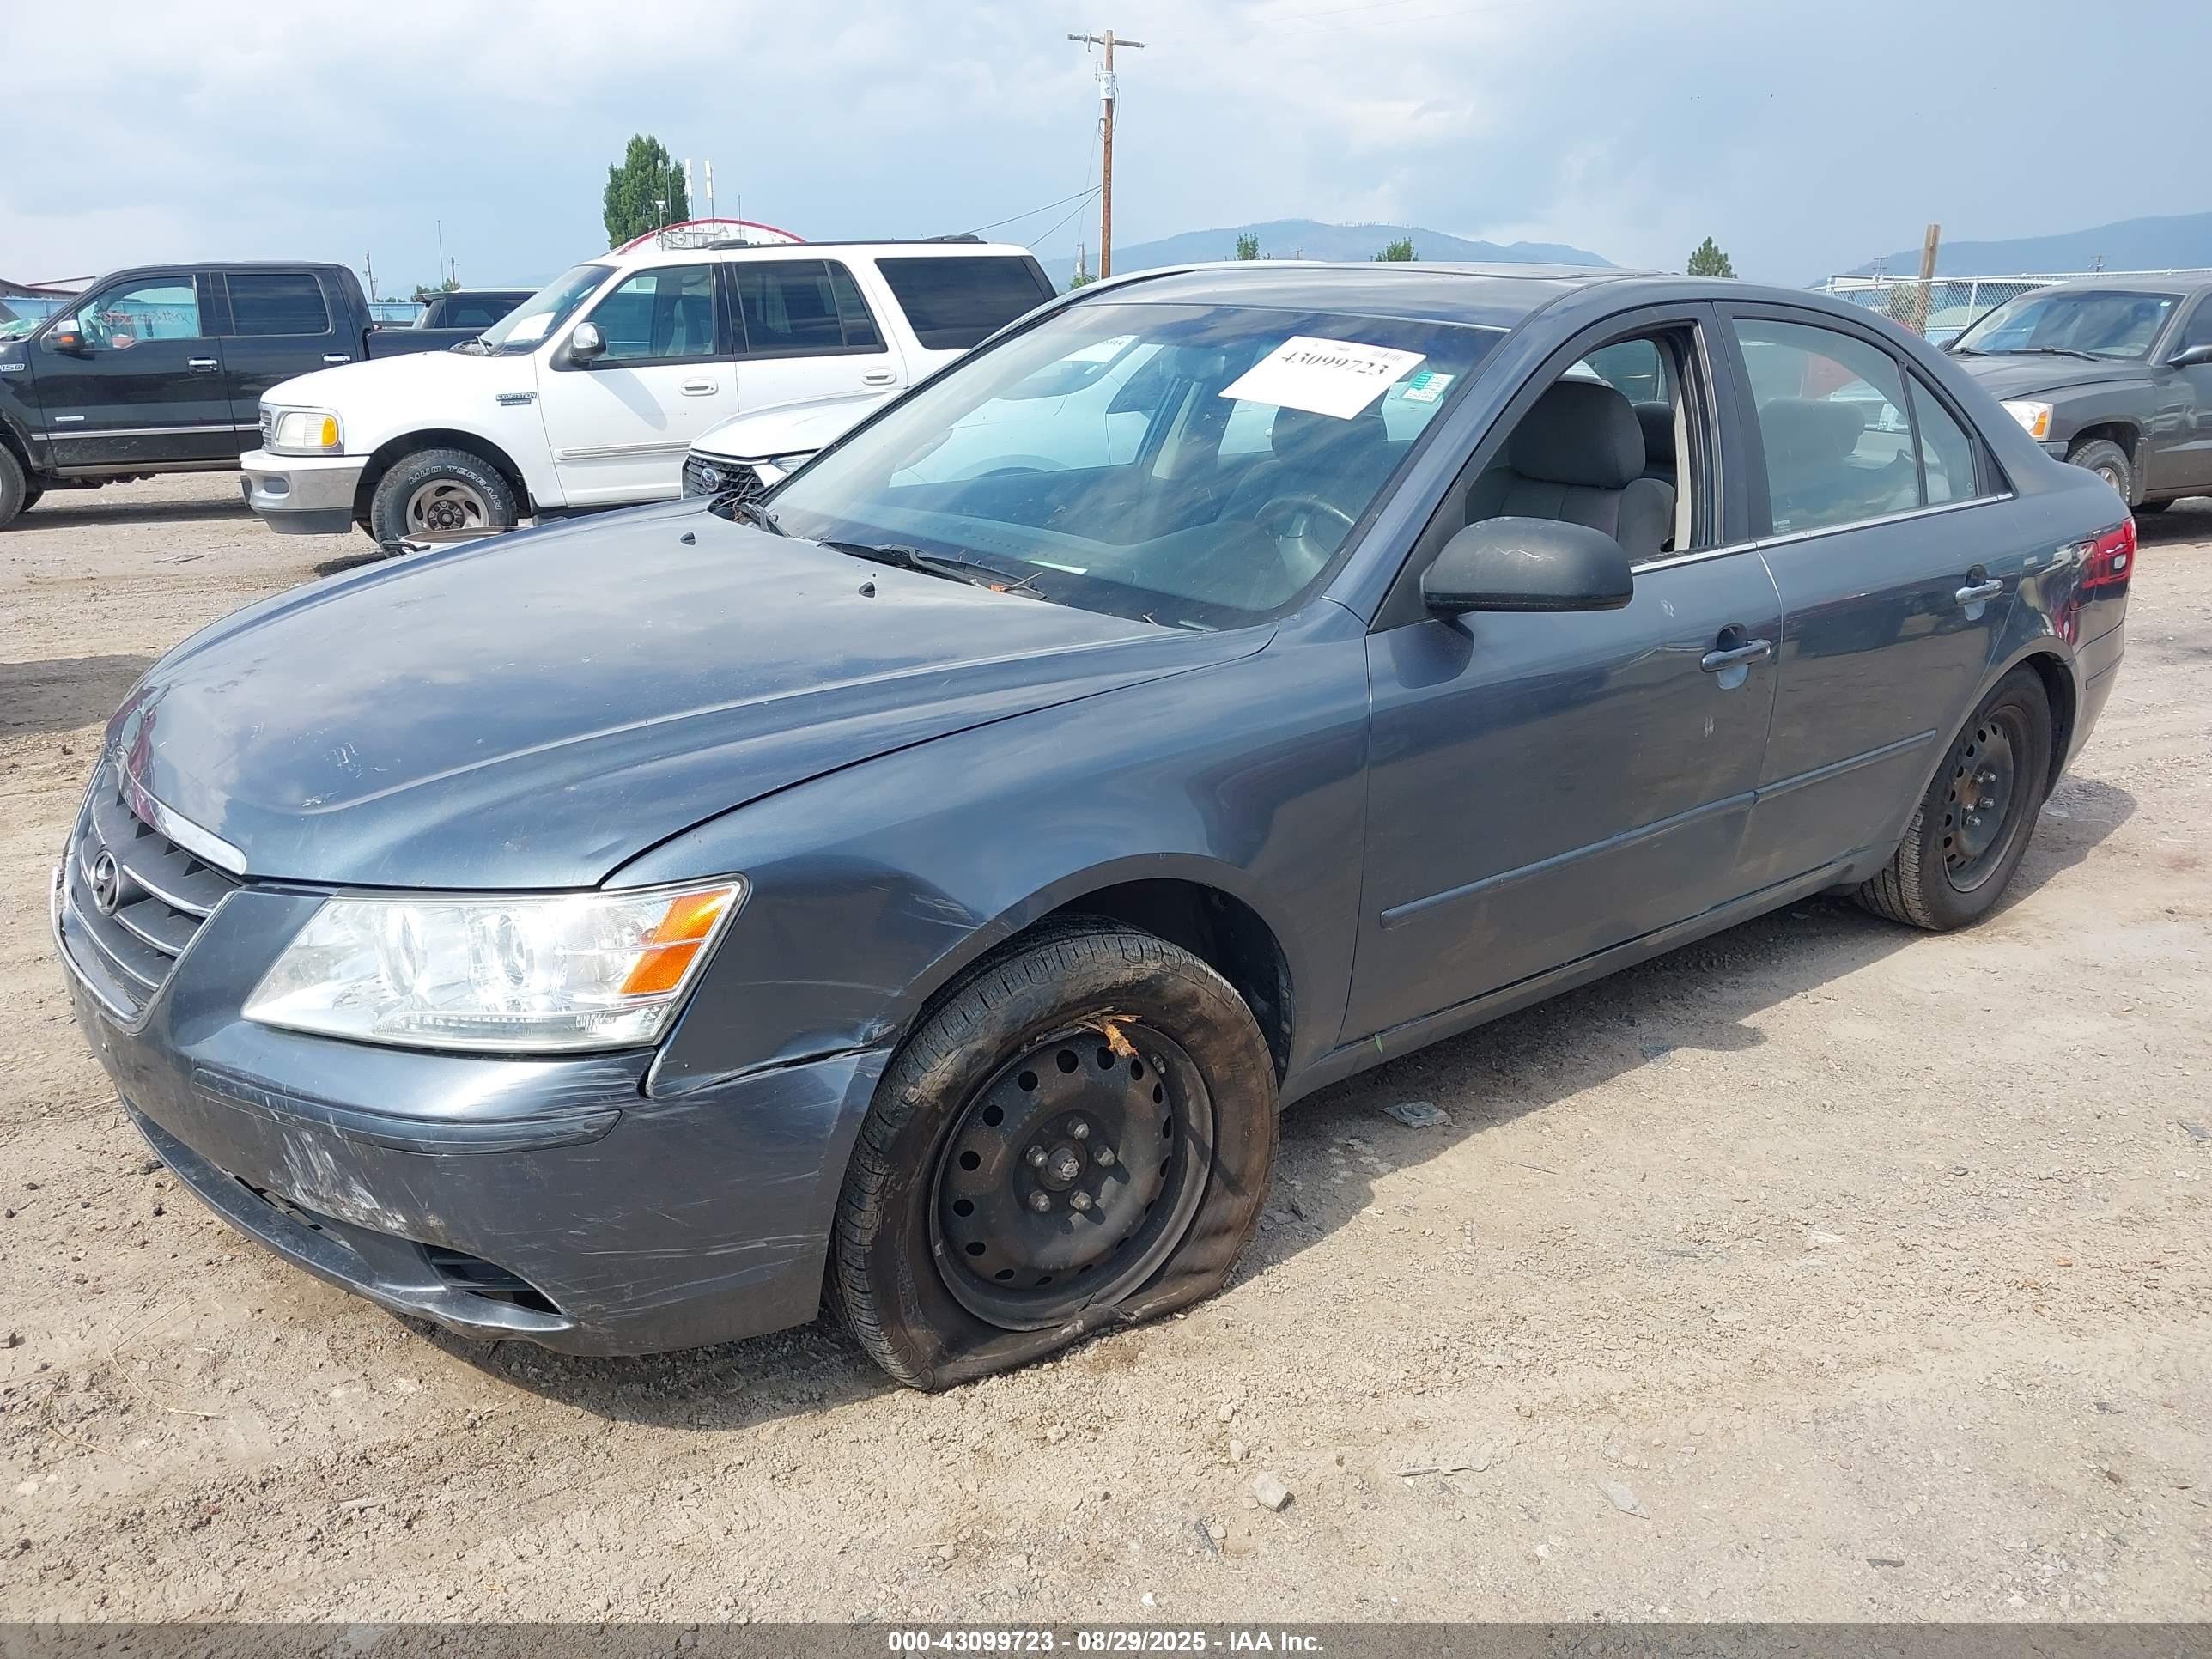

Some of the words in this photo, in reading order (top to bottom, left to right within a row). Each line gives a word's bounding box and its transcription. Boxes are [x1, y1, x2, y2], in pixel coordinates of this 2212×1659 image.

[1281, 350, 1389, 376] 43099723
[495, 392, 538, 401] EXPEDITION
[408, 465, 441, 485] MUD
[447, 465, 502, 510] TERRAIN
